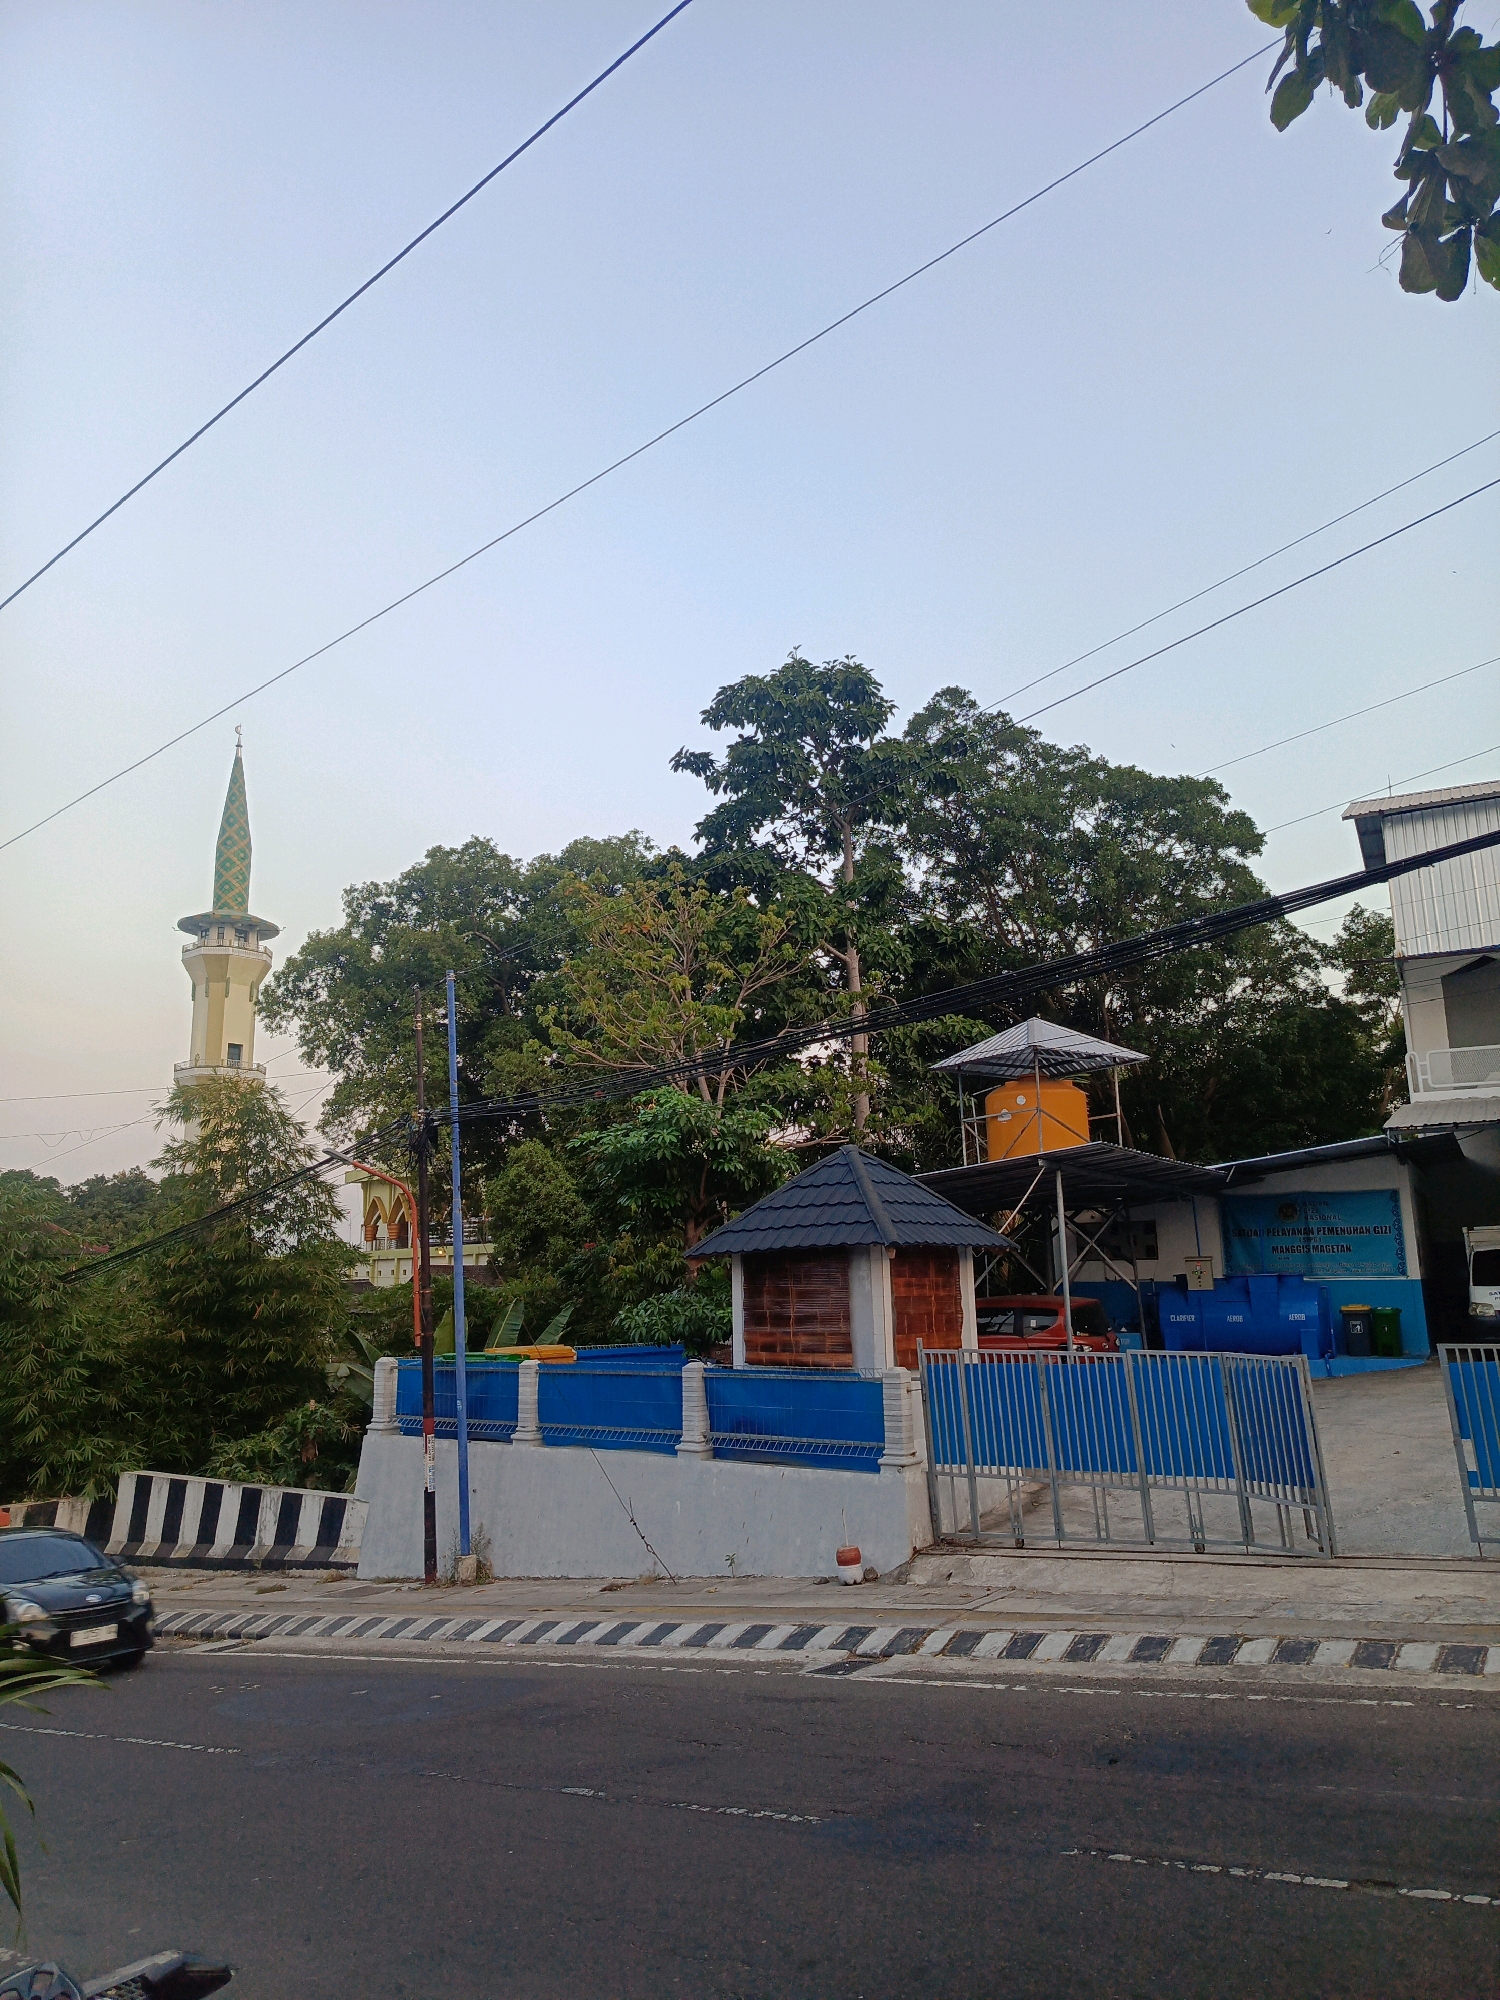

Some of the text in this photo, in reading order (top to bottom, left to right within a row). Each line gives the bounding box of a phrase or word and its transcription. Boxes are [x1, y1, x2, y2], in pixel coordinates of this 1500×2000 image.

[1266, 1226, 1315, 1238] PELAYANAN
[1316, 1225, 1371, 1236] PEMENUHAN
[1373, 1225, 1392, 1235] GIZI
[1271, 1243, 1352, 1254] MANGGIS MAGETAN
[1170, 1314, 1196, 1322] CLARIFIER
[1226, 1315, 1244, 1323] AEROB
[1288, 1313, 1306, 1321] AEROB
